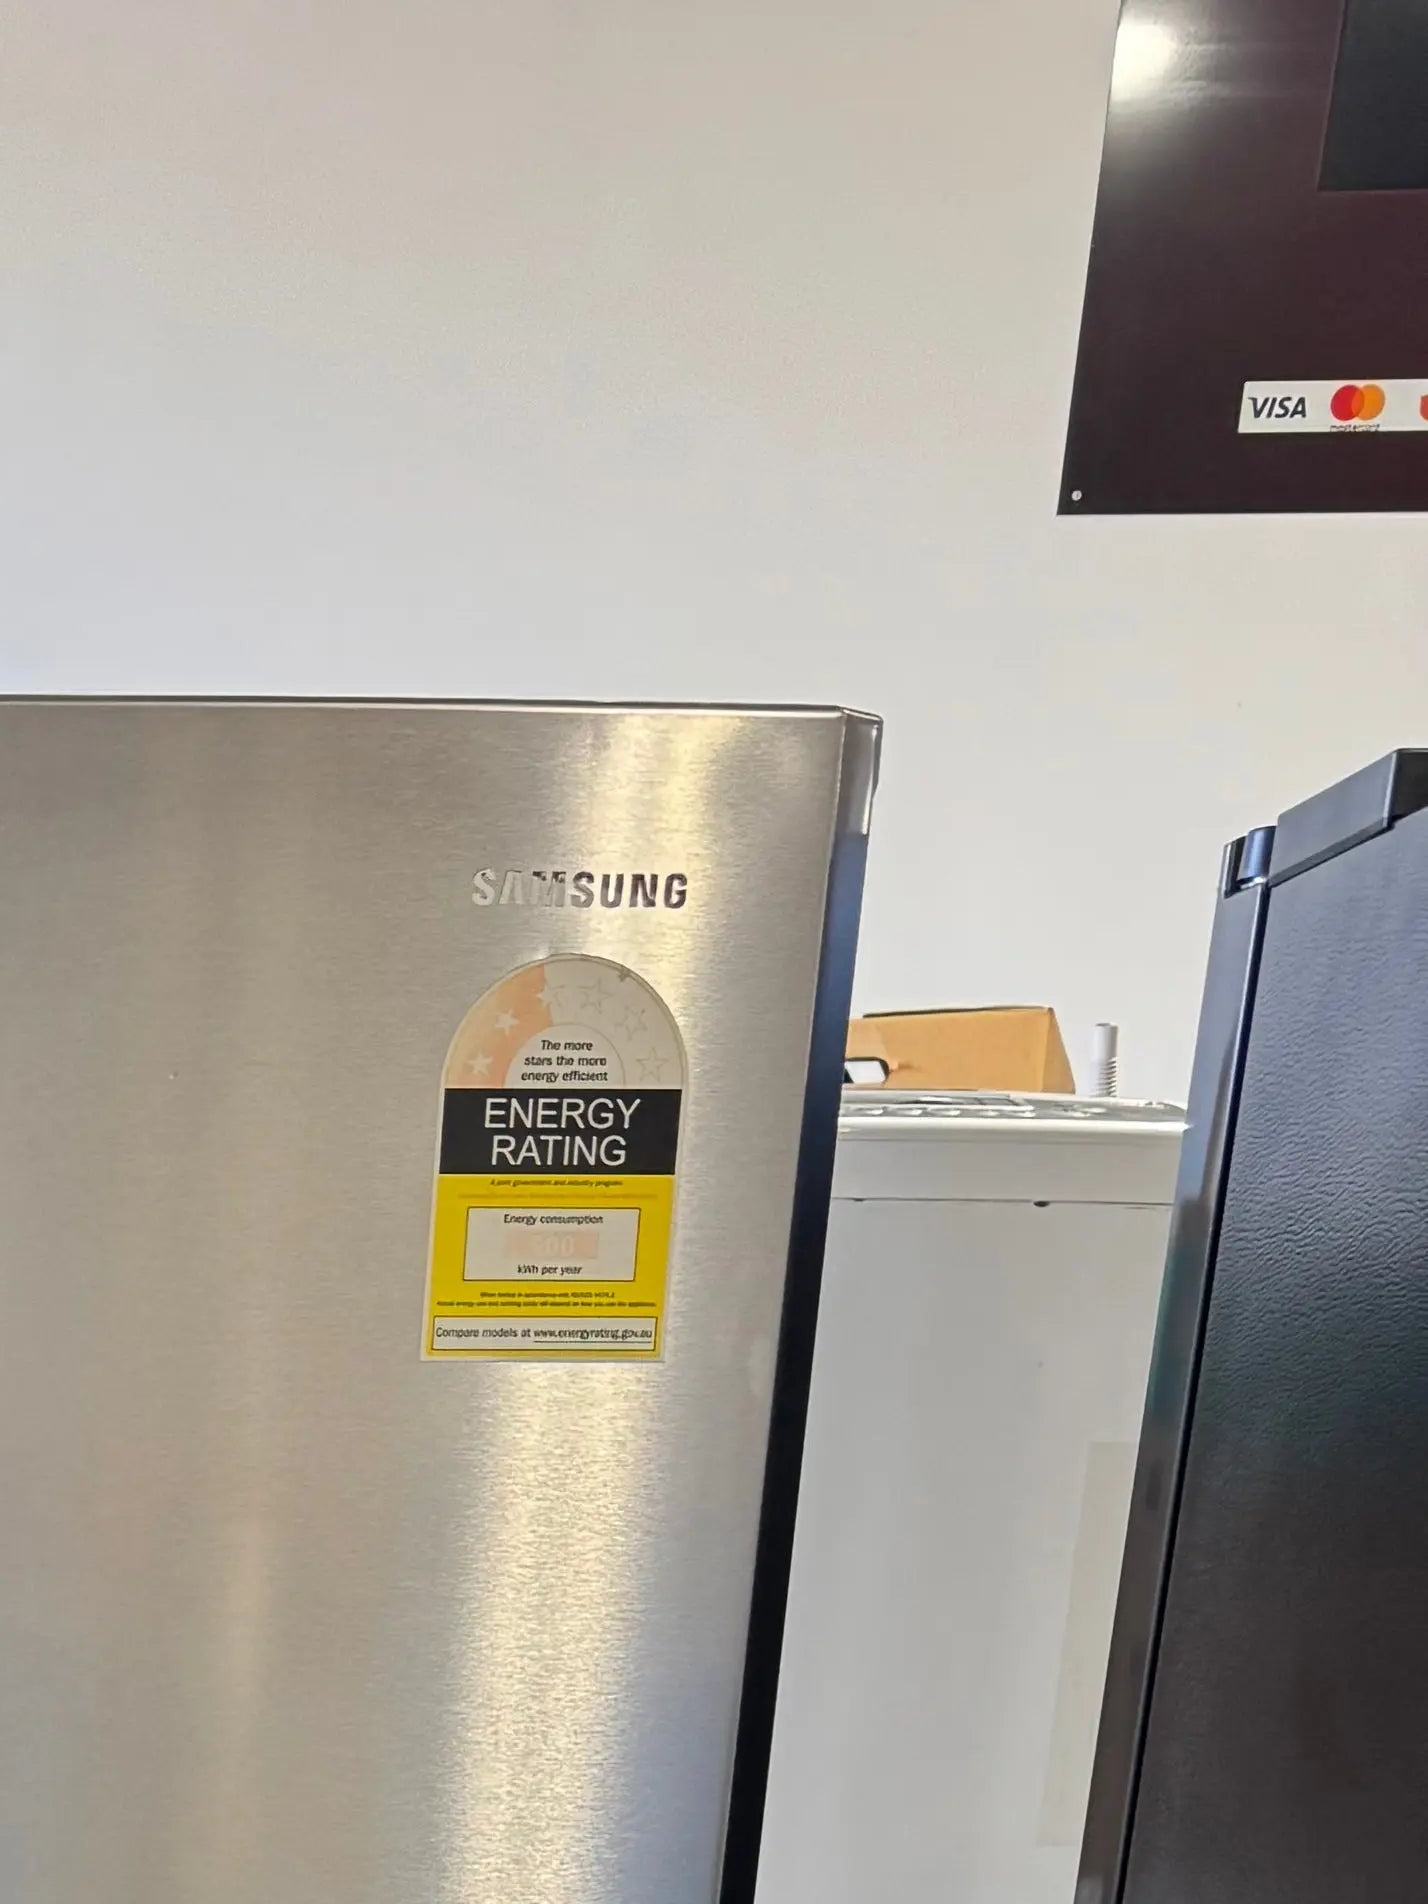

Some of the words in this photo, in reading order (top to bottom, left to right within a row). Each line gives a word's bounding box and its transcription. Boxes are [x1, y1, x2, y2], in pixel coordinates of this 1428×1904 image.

[1248, 396, 1306, 419] VISA
[471, 868, 688, 909] SAMSUNG
[541, 1039, 561, 1050] The
[564, 1042, 593, 1051] more
[524, 1056, 552, 1066] stars
[556, 1056, 574, 1066] the
[577, 1057, 607, 1066] more
[521, 1072, 559, 1083] energy
[562, 1071, 608, 1081] efficient
[484, 1098, 641, 1129] ENERGY
[491, 1135, 626, 1166] RATING
[503, 1213, 536, 1226] Energy
[539, 1213, 604, 1225] consumption
[517, 1264, 539, 1274] kWh
[541, 1266, 558, 1276] per
[560, 1266, 583, 1276] year
[436, 1326, 480, 1338] Compare
[482, 1327, 518, 1338] models
[520, 1328, 532, 1338] at
[533, 1328, 653, 1341] www.energyrating.gov.au
